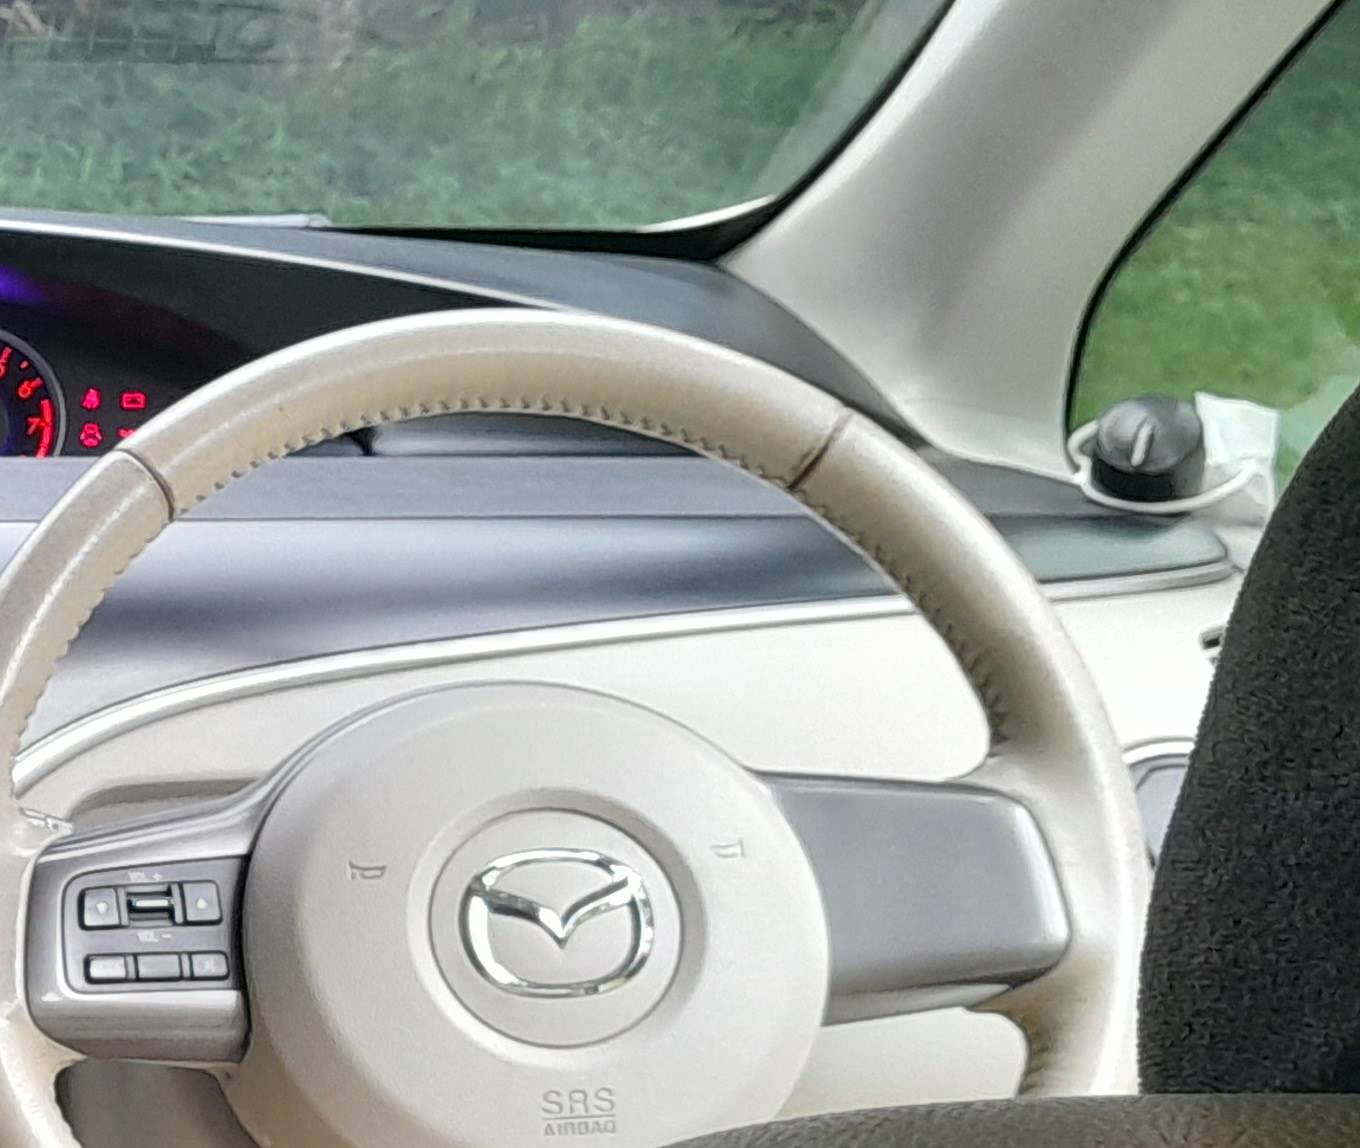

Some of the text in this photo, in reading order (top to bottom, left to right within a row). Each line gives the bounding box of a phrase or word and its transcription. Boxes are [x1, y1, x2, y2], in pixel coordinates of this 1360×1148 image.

[17, 381, 33, 399] 6
[27, 417, 41, 435] 7
[541, 1086, 616, 1115] SRS
